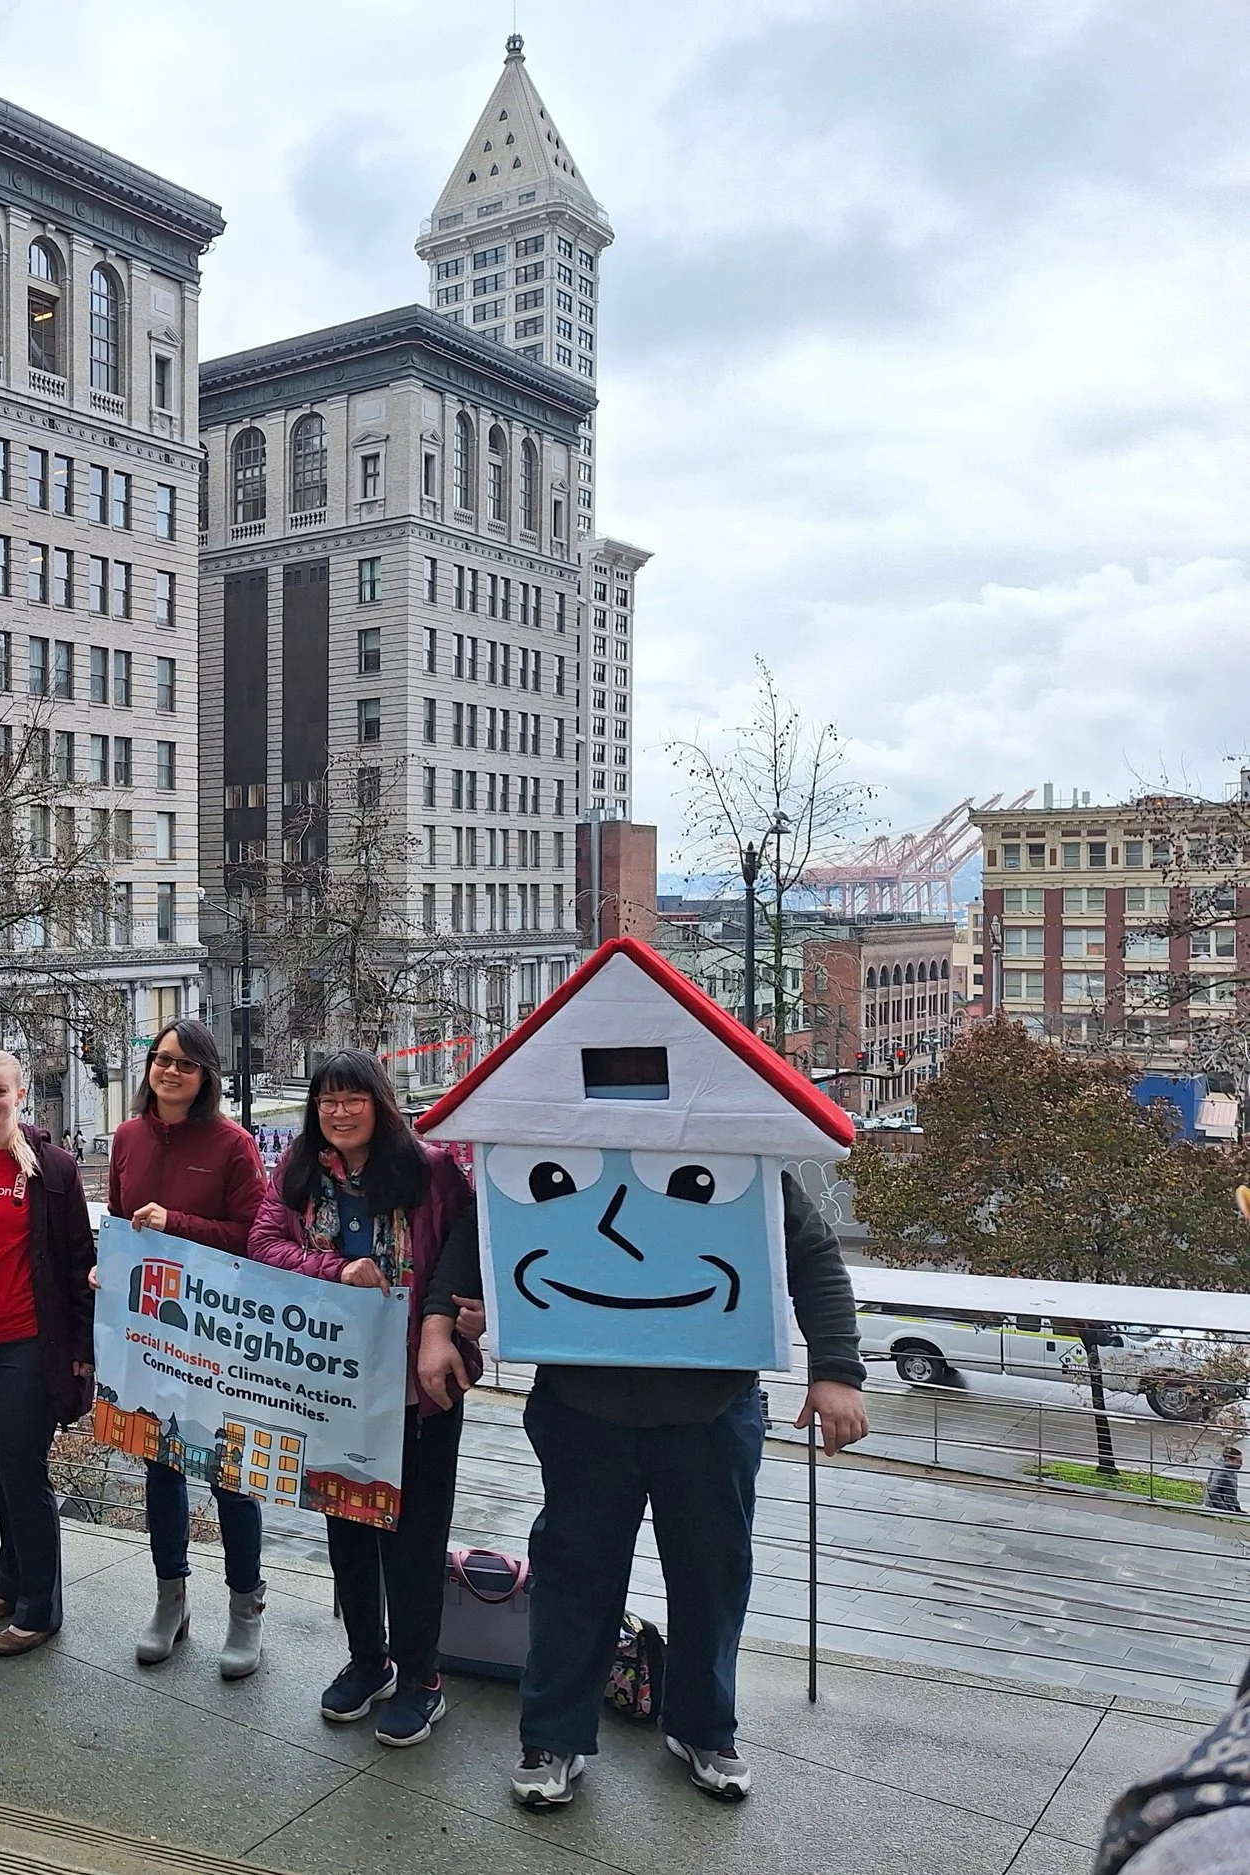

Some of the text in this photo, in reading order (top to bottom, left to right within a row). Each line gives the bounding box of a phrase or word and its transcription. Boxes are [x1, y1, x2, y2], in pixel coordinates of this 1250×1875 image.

[184, 1273, 344, 1343] House Our
[124, 1327, 357, 1410] Social Housing. Climate Action.
[193, 1311, 360, 1379] Neighbors
[142, 1352, 330, 1423] Connected Communities.
